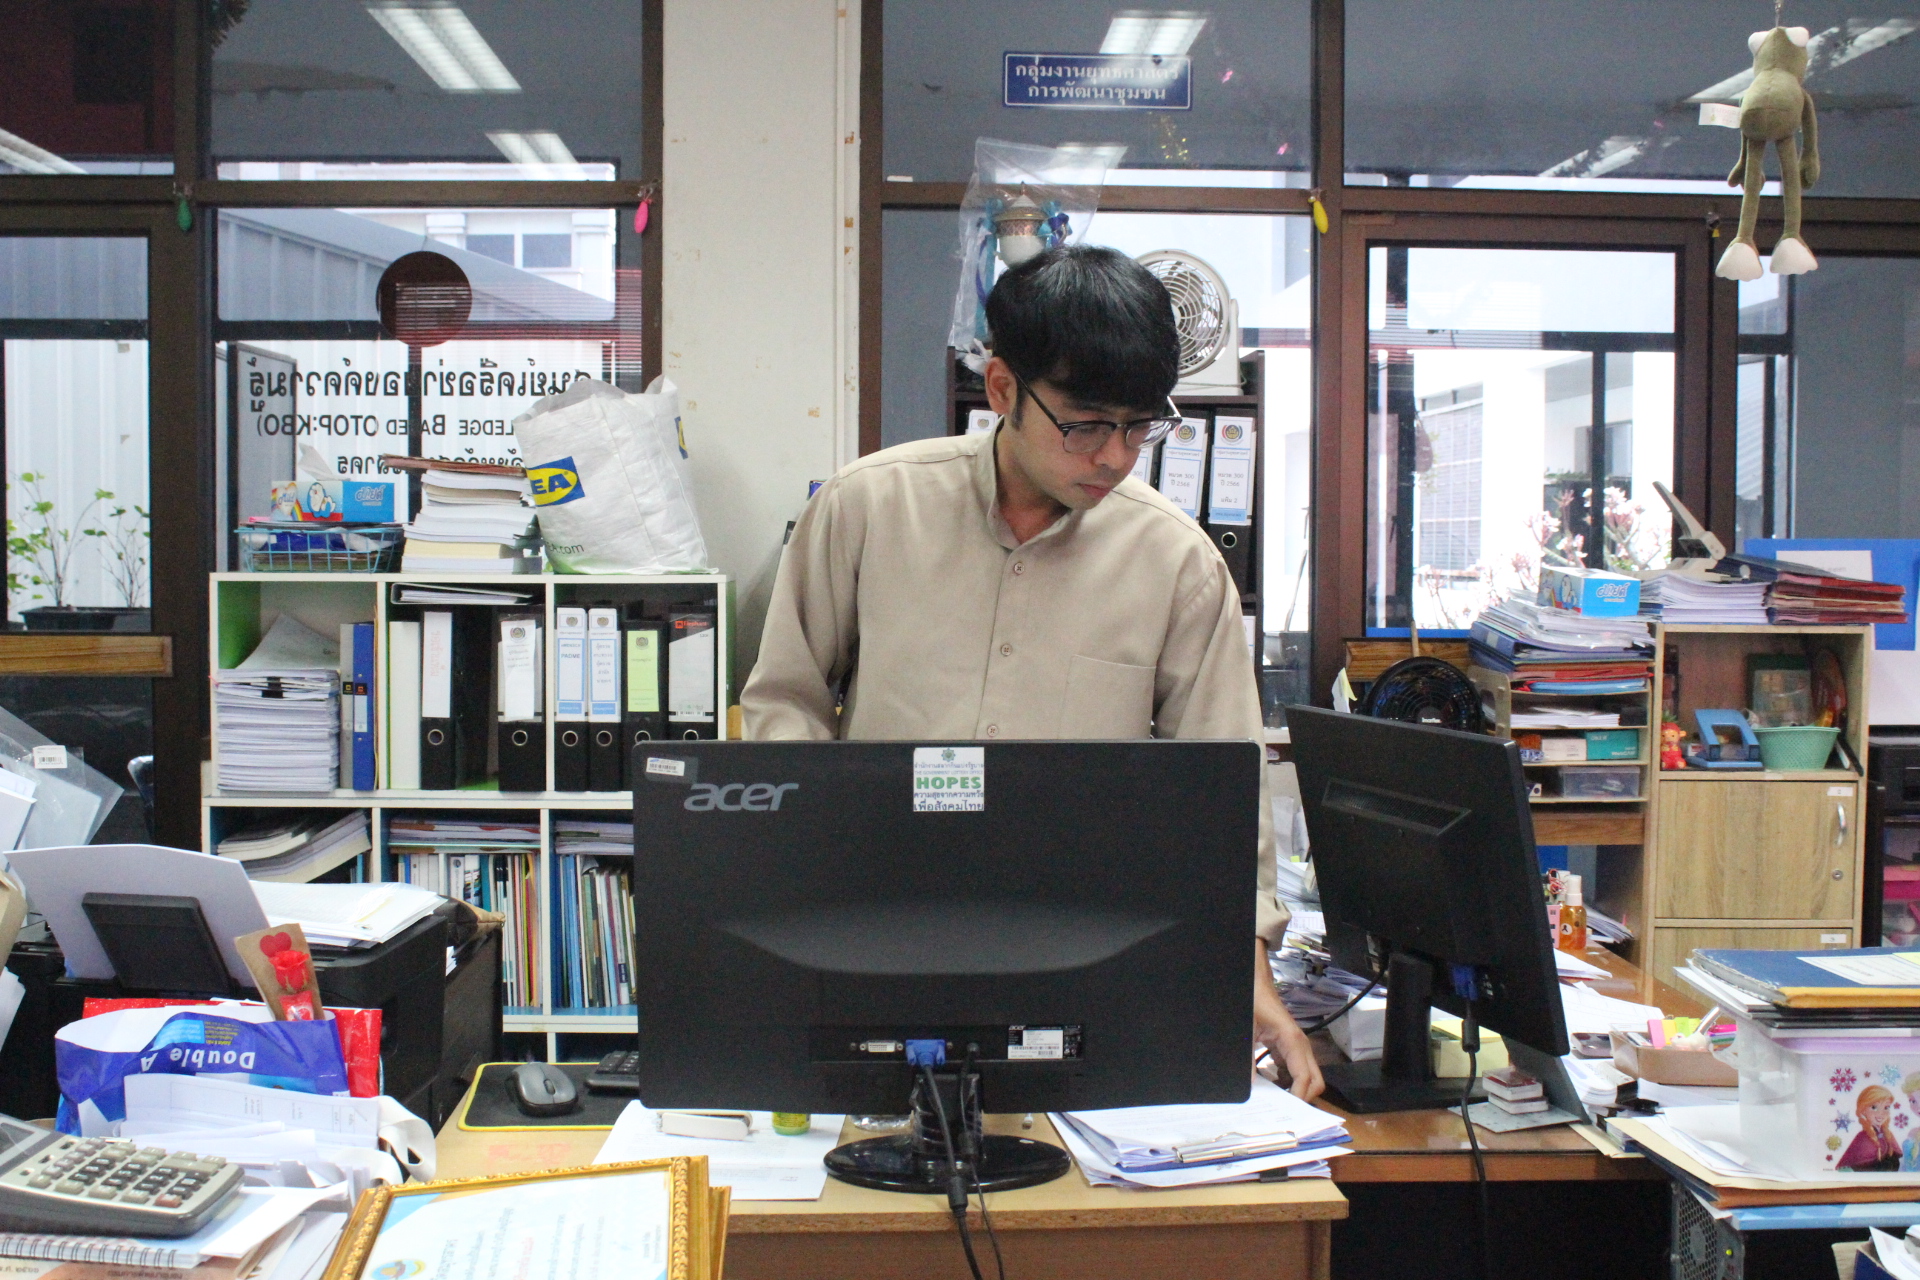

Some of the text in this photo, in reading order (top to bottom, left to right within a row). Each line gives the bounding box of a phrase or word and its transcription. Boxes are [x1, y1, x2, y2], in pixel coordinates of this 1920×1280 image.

[1028, 81, 1167, 105] การพัฒนาชุมชน
[530, 473, 572, 495] EA
[547, 542, 585, 555] EA.com
[916, 776, 982, 789] HOPES
[684, 782, 800, 811] acer
[140, 1047, 256, 1073] Double A
